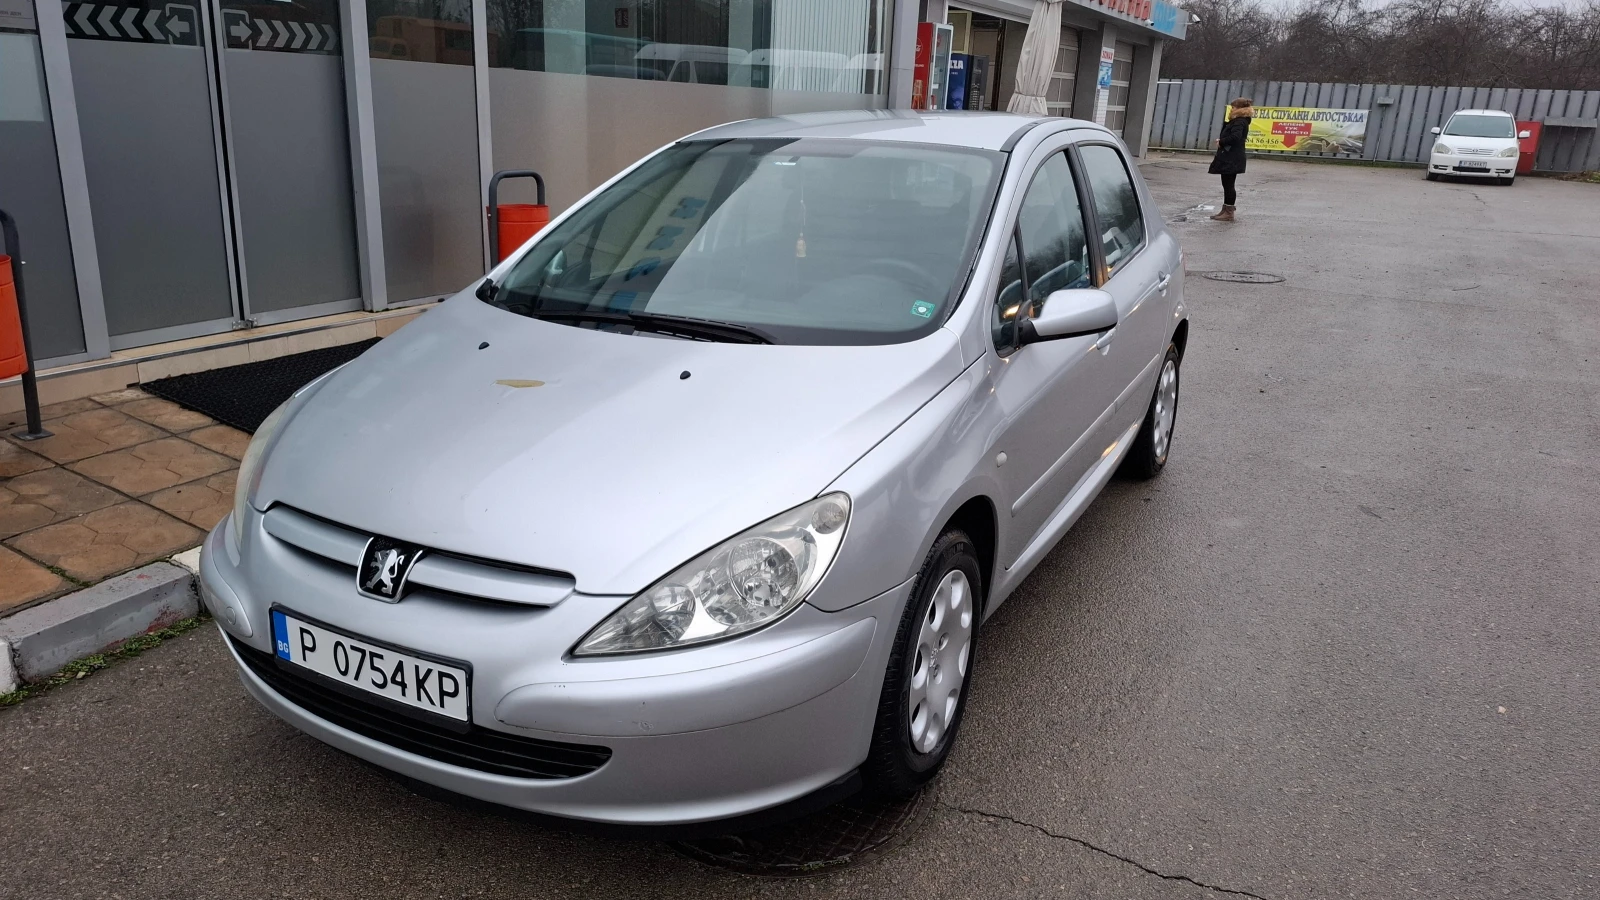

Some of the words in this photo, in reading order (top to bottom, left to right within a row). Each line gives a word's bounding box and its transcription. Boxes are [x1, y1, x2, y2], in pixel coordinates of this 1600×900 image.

[1259, 109, 1270, 119] НА
[1271, 110, 1309, 121] СПУКАНИ
[1310, 111, 1364, 123] АВТОСТЪКЛА
[278, 639, 289, 654] BG
[299, 626, 317, 662] P
[333, 640, 460, 709] 0754KP
